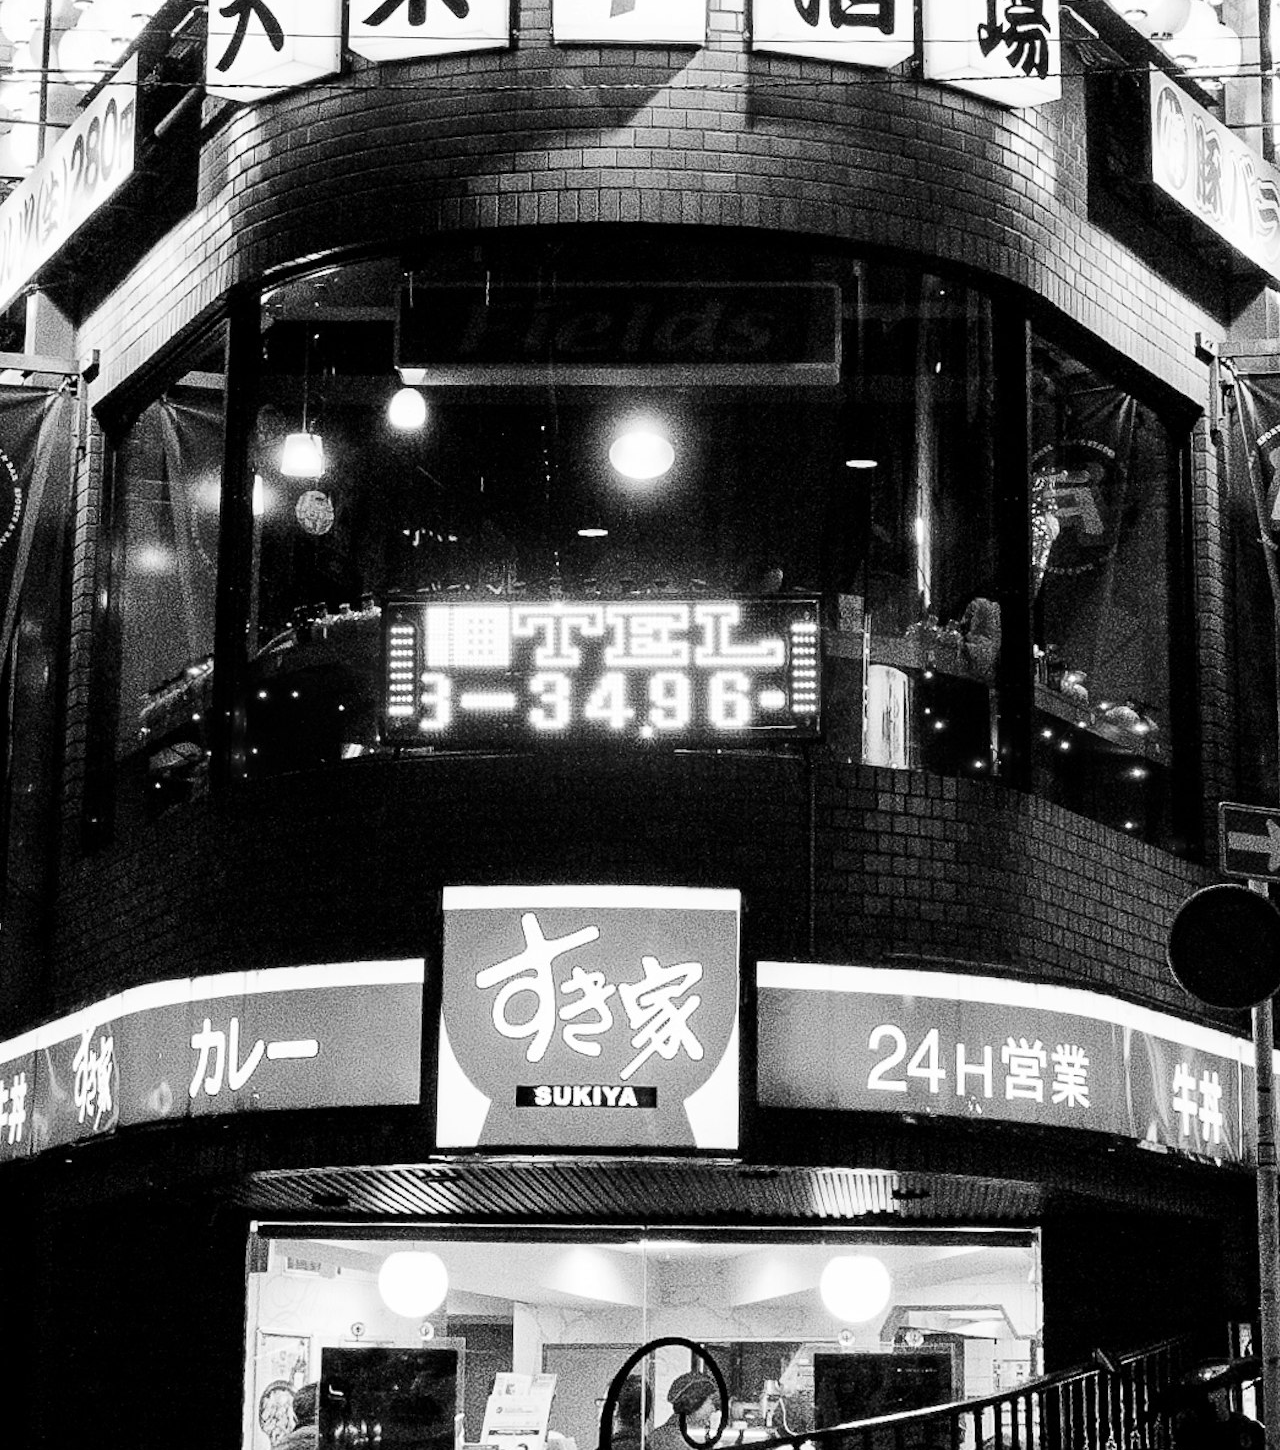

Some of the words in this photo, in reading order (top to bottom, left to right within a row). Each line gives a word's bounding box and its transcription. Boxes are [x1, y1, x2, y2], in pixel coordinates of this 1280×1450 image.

[511, 605, 786, 667] TEL
[475, 910, 705, 1081] すき家
[73, 1024, 116, 1131] すき家
[188, 1016, 320, 1100] カレー
[532, 1084, 640, 1108] SUKIYA
[865, 1023, 1093, 1112] 24H営業
[1170, 1059, 1225, 1145] 牛丼
